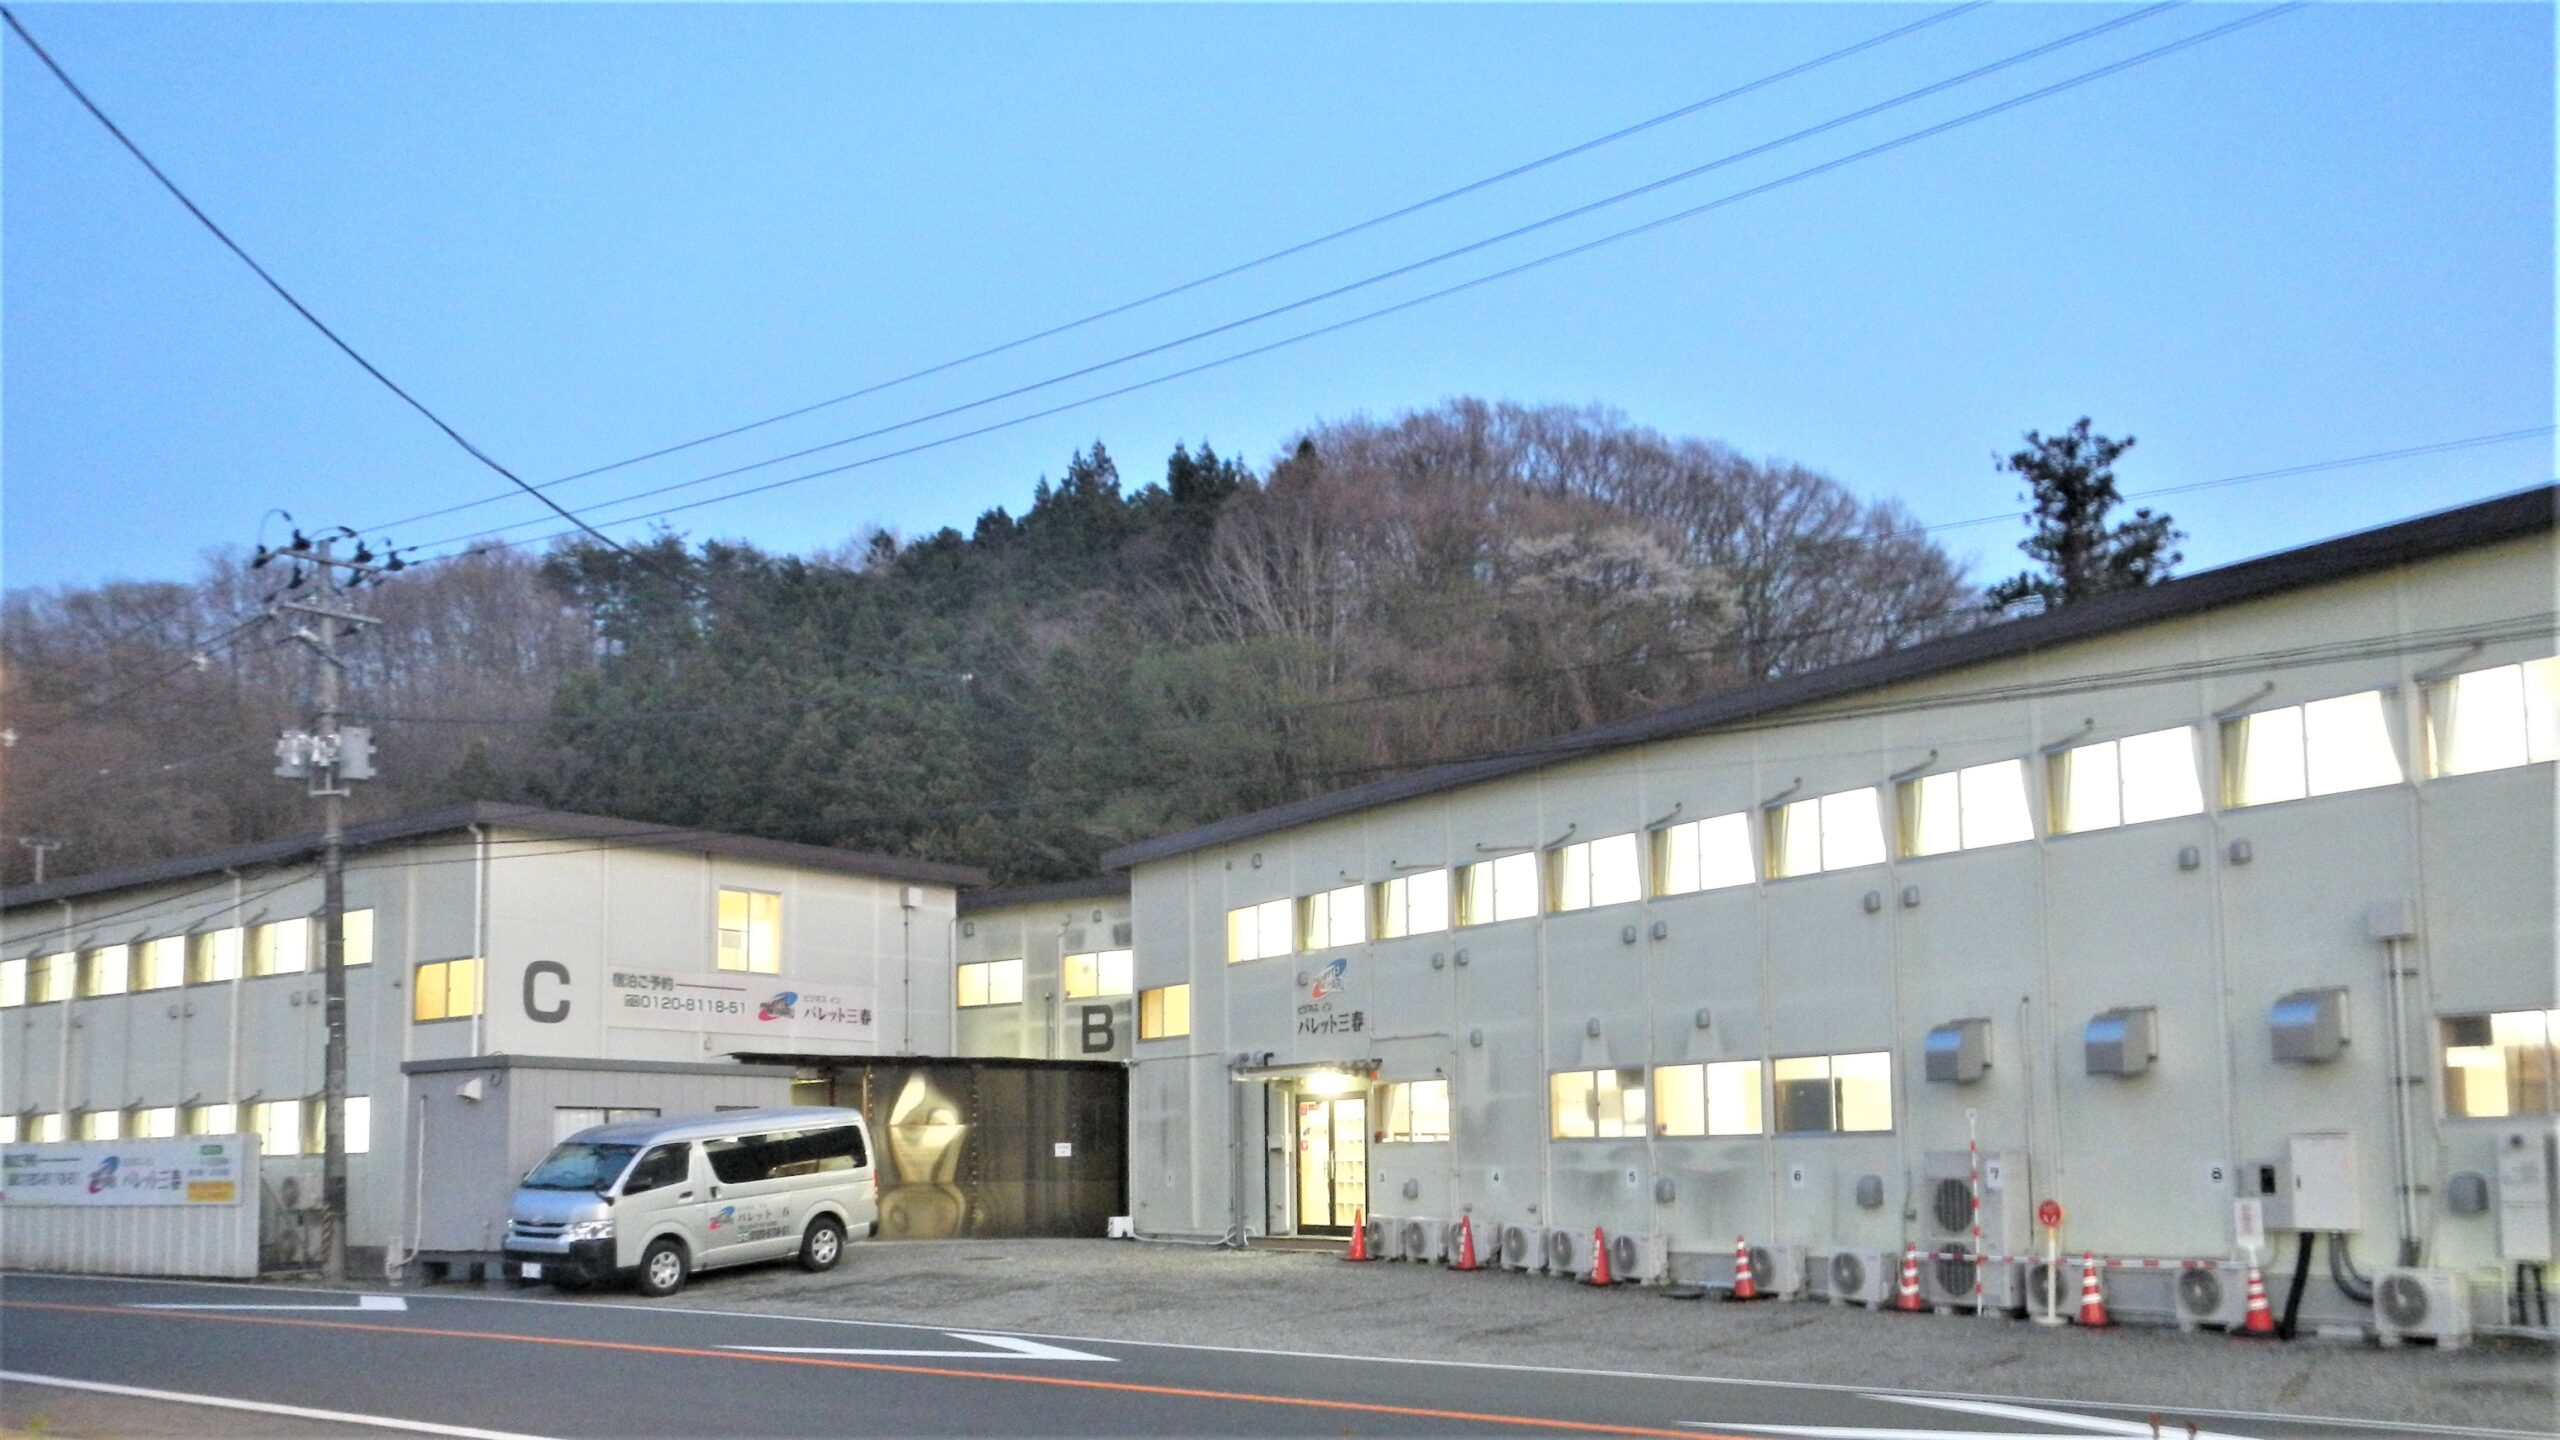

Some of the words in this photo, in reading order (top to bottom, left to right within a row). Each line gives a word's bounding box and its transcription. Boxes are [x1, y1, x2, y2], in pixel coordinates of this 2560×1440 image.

[524, 961, 570, 1024] C
[641, 995, 746, 1015] 0120-8118-51
[1081, 1003, 1115, 1054] B
[1298, 1009, 1364, 1034] パレット三春
[1629, 1172, 1635, 1182] 5
[1794, 1171, 1800, 1181] 6
[1990, 1167, 1999, 1181] 7
